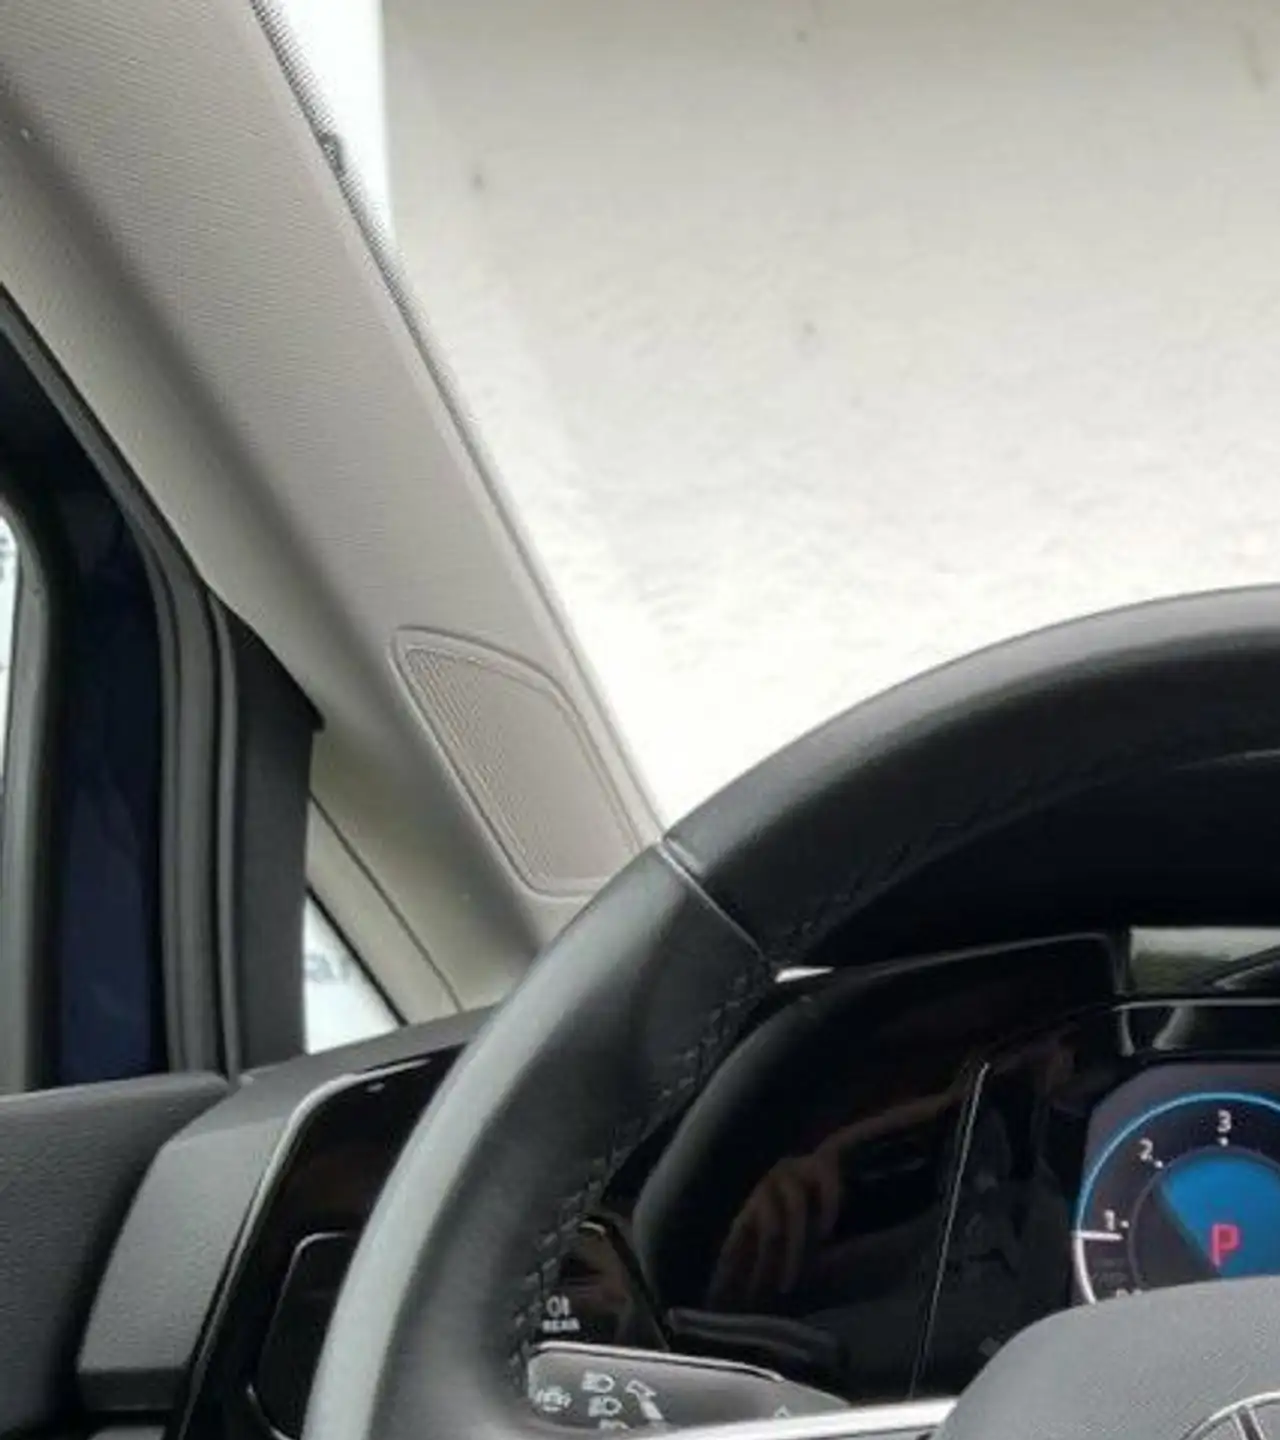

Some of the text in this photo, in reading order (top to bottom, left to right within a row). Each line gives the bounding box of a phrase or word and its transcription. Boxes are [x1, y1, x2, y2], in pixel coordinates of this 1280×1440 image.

[1216, 1109, 1232, 1134] 3
[1138, 1138, 1154, 1161] 2
[1211, 1223, 1240, 1268] P
